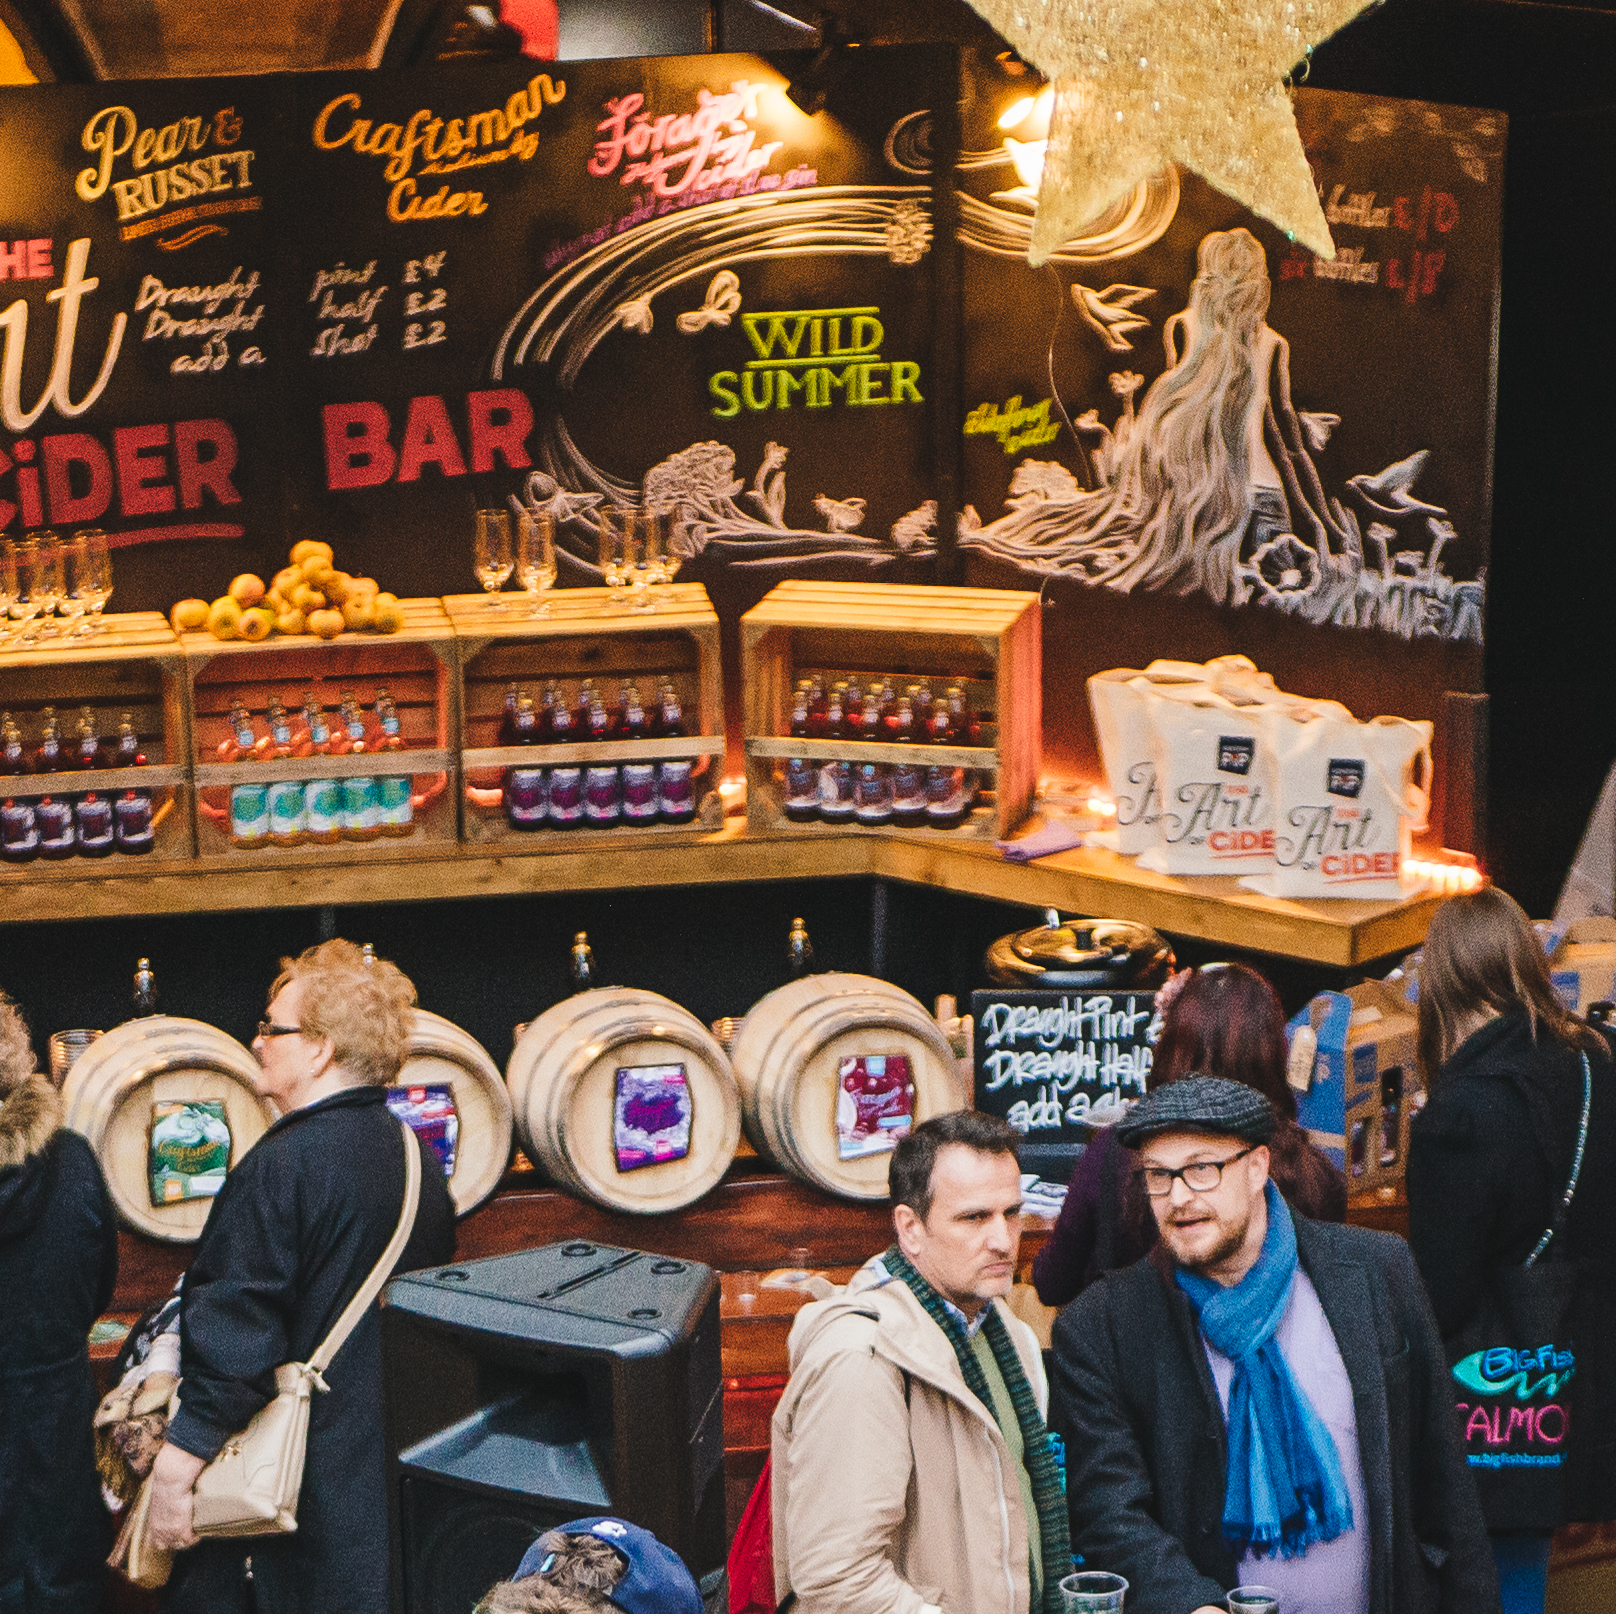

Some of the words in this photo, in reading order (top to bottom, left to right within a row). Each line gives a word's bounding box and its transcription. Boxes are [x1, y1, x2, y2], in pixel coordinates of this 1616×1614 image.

[75, 104, 208, 202] Pear
[212, 106, 245, 144] &
[312, 73, 566, 182] Craftsman
[111, 148, 257, 222] RUSSET
[386, 177, 489, 223] Cider
[403, 287, 448, 316] £2
[238, 345, 267, 367] a
[402, 320, 447, 350] £2
[741, 313, 885, 360] WILD
[707, 360, 925, 418] SUMMER
[320, 387, 536, 491] BAR
[1155, 781, 1262, 844] Art
[1208, 829, 1276, 852] CiDE
[1274, 804, 1373, 867] Art
